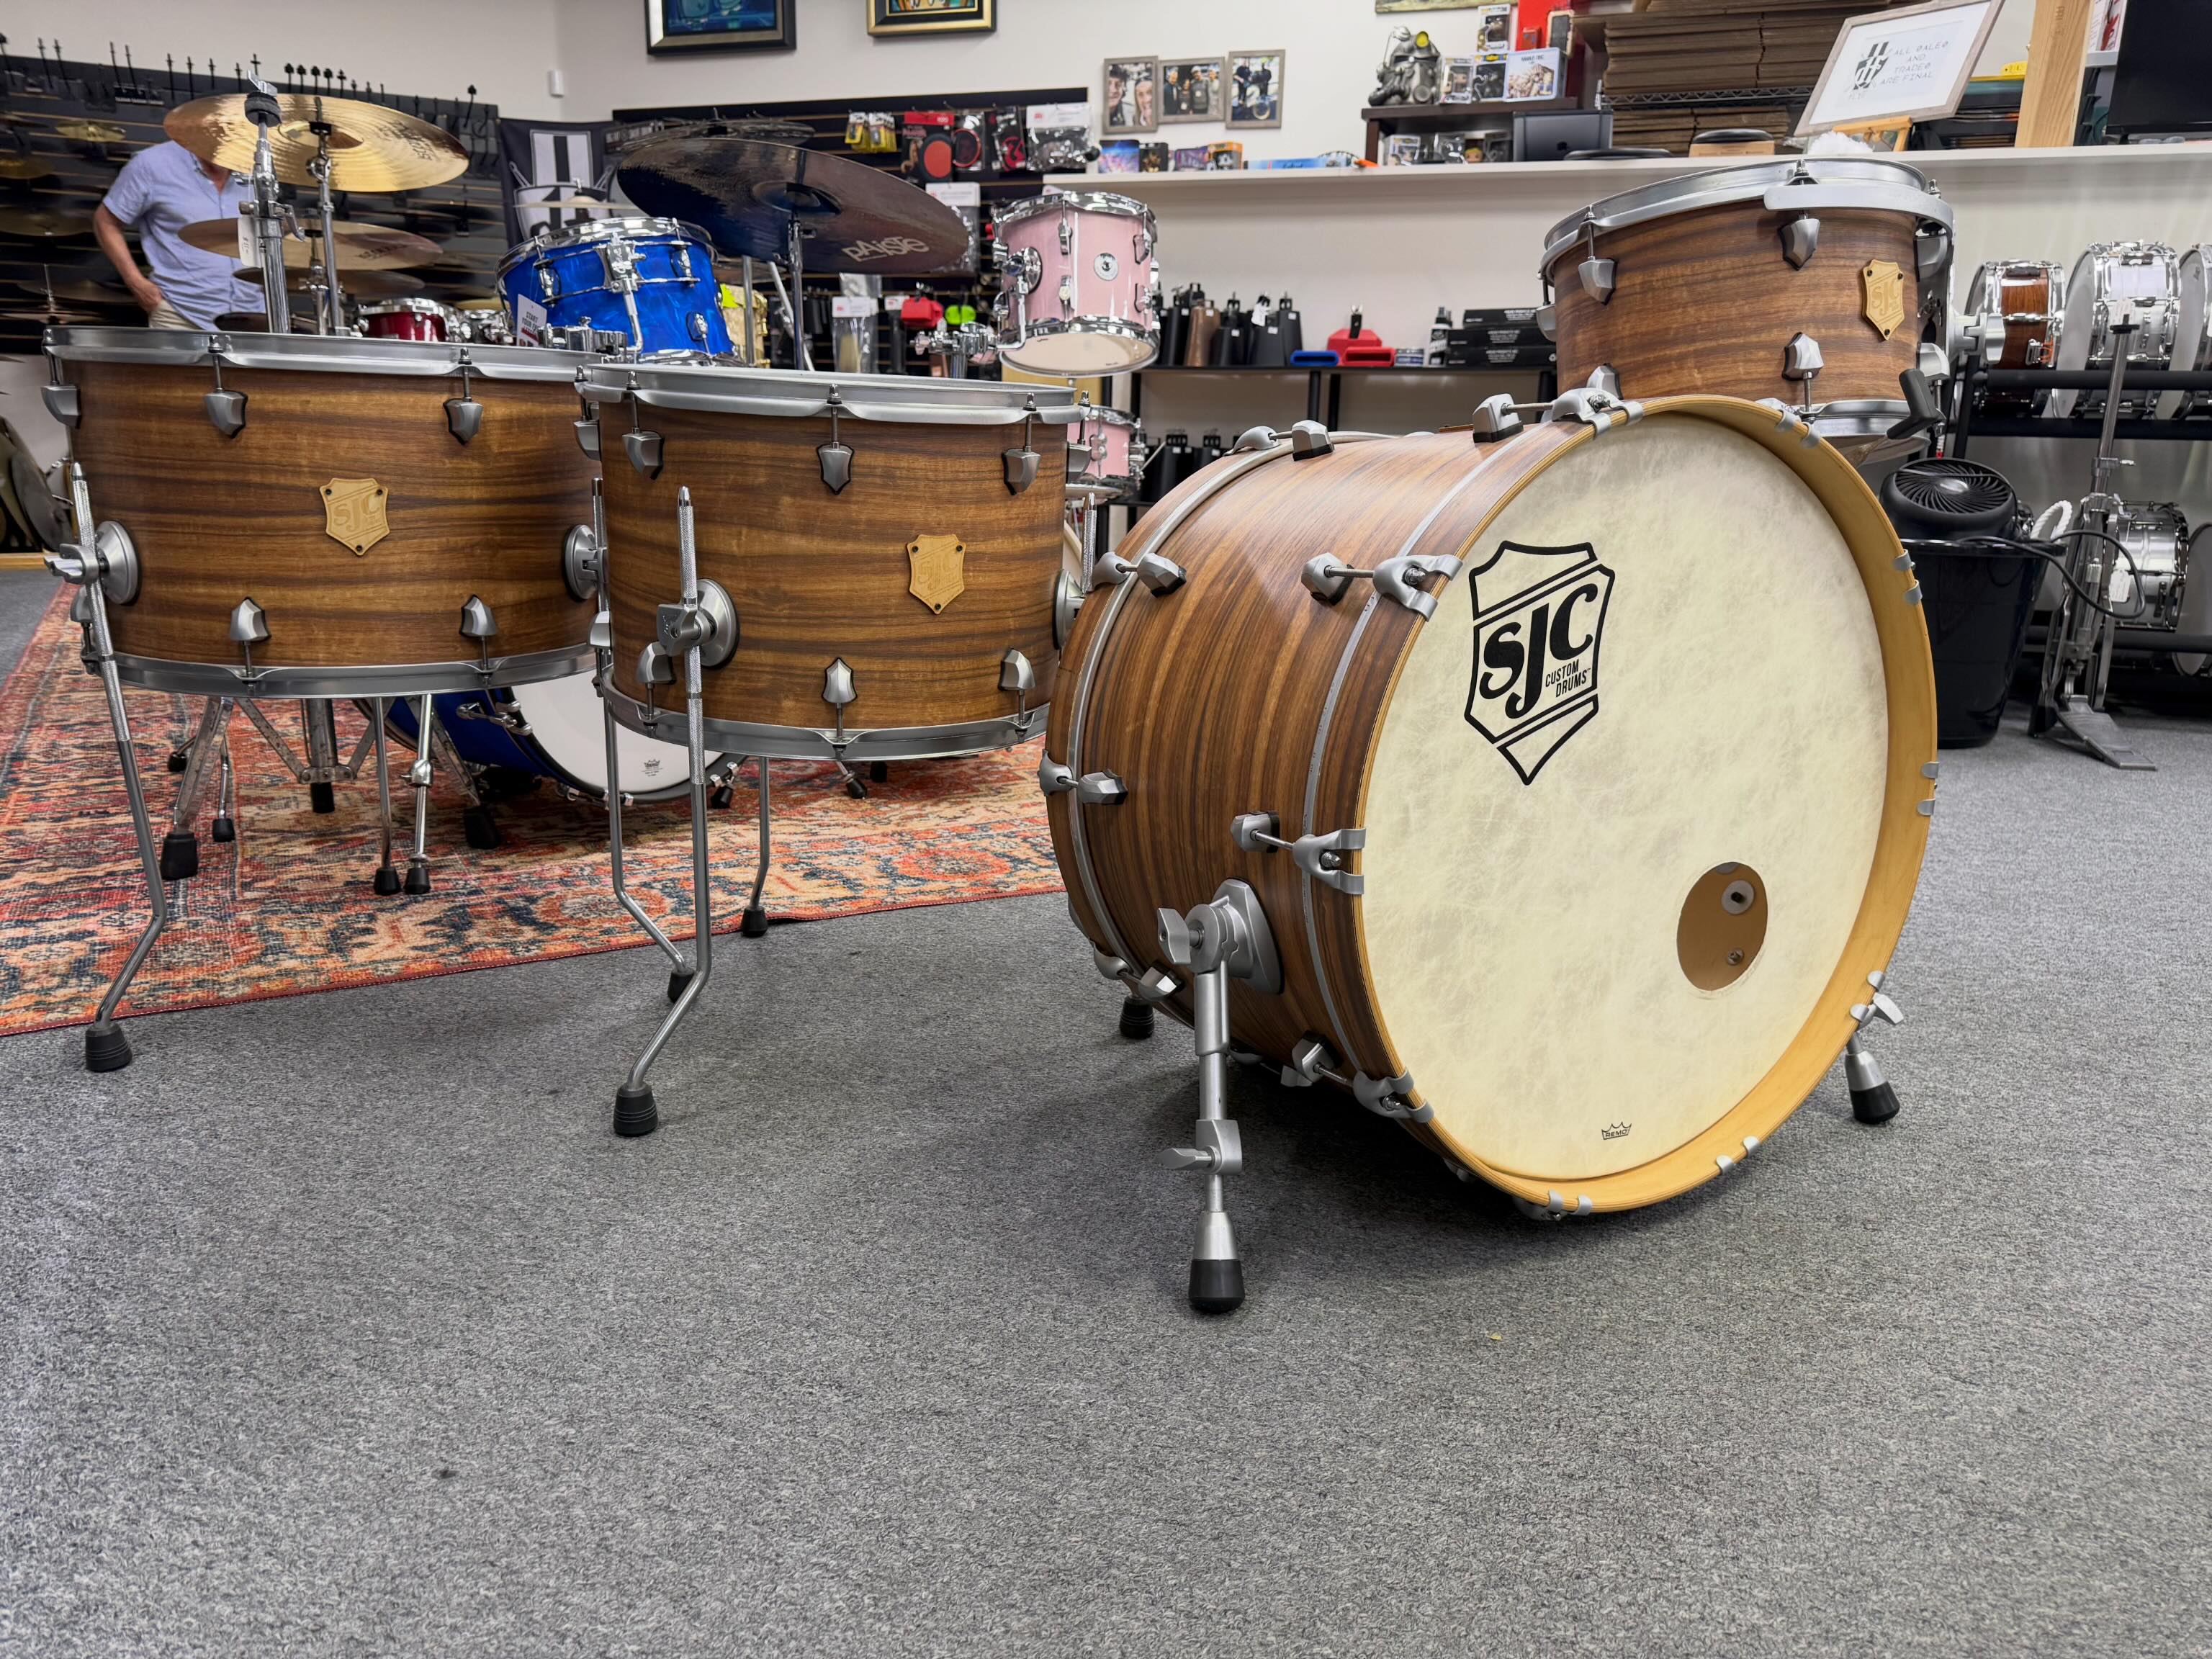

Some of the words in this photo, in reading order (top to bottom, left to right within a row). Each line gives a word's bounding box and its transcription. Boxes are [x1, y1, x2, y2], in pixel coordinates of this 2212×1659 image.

[1907, 53, 1926, 62] AND
[1879, 76, 1900, 85] ARE
[334, 493, 381, 532] SJC
[1479, 583, 1598, 719] SJC
[1545, 658, 1579, 688] CUSTOM
[1555, 669, 1588, 698] DRUMS
[1605, 1129, 1627, 1138] REMO
